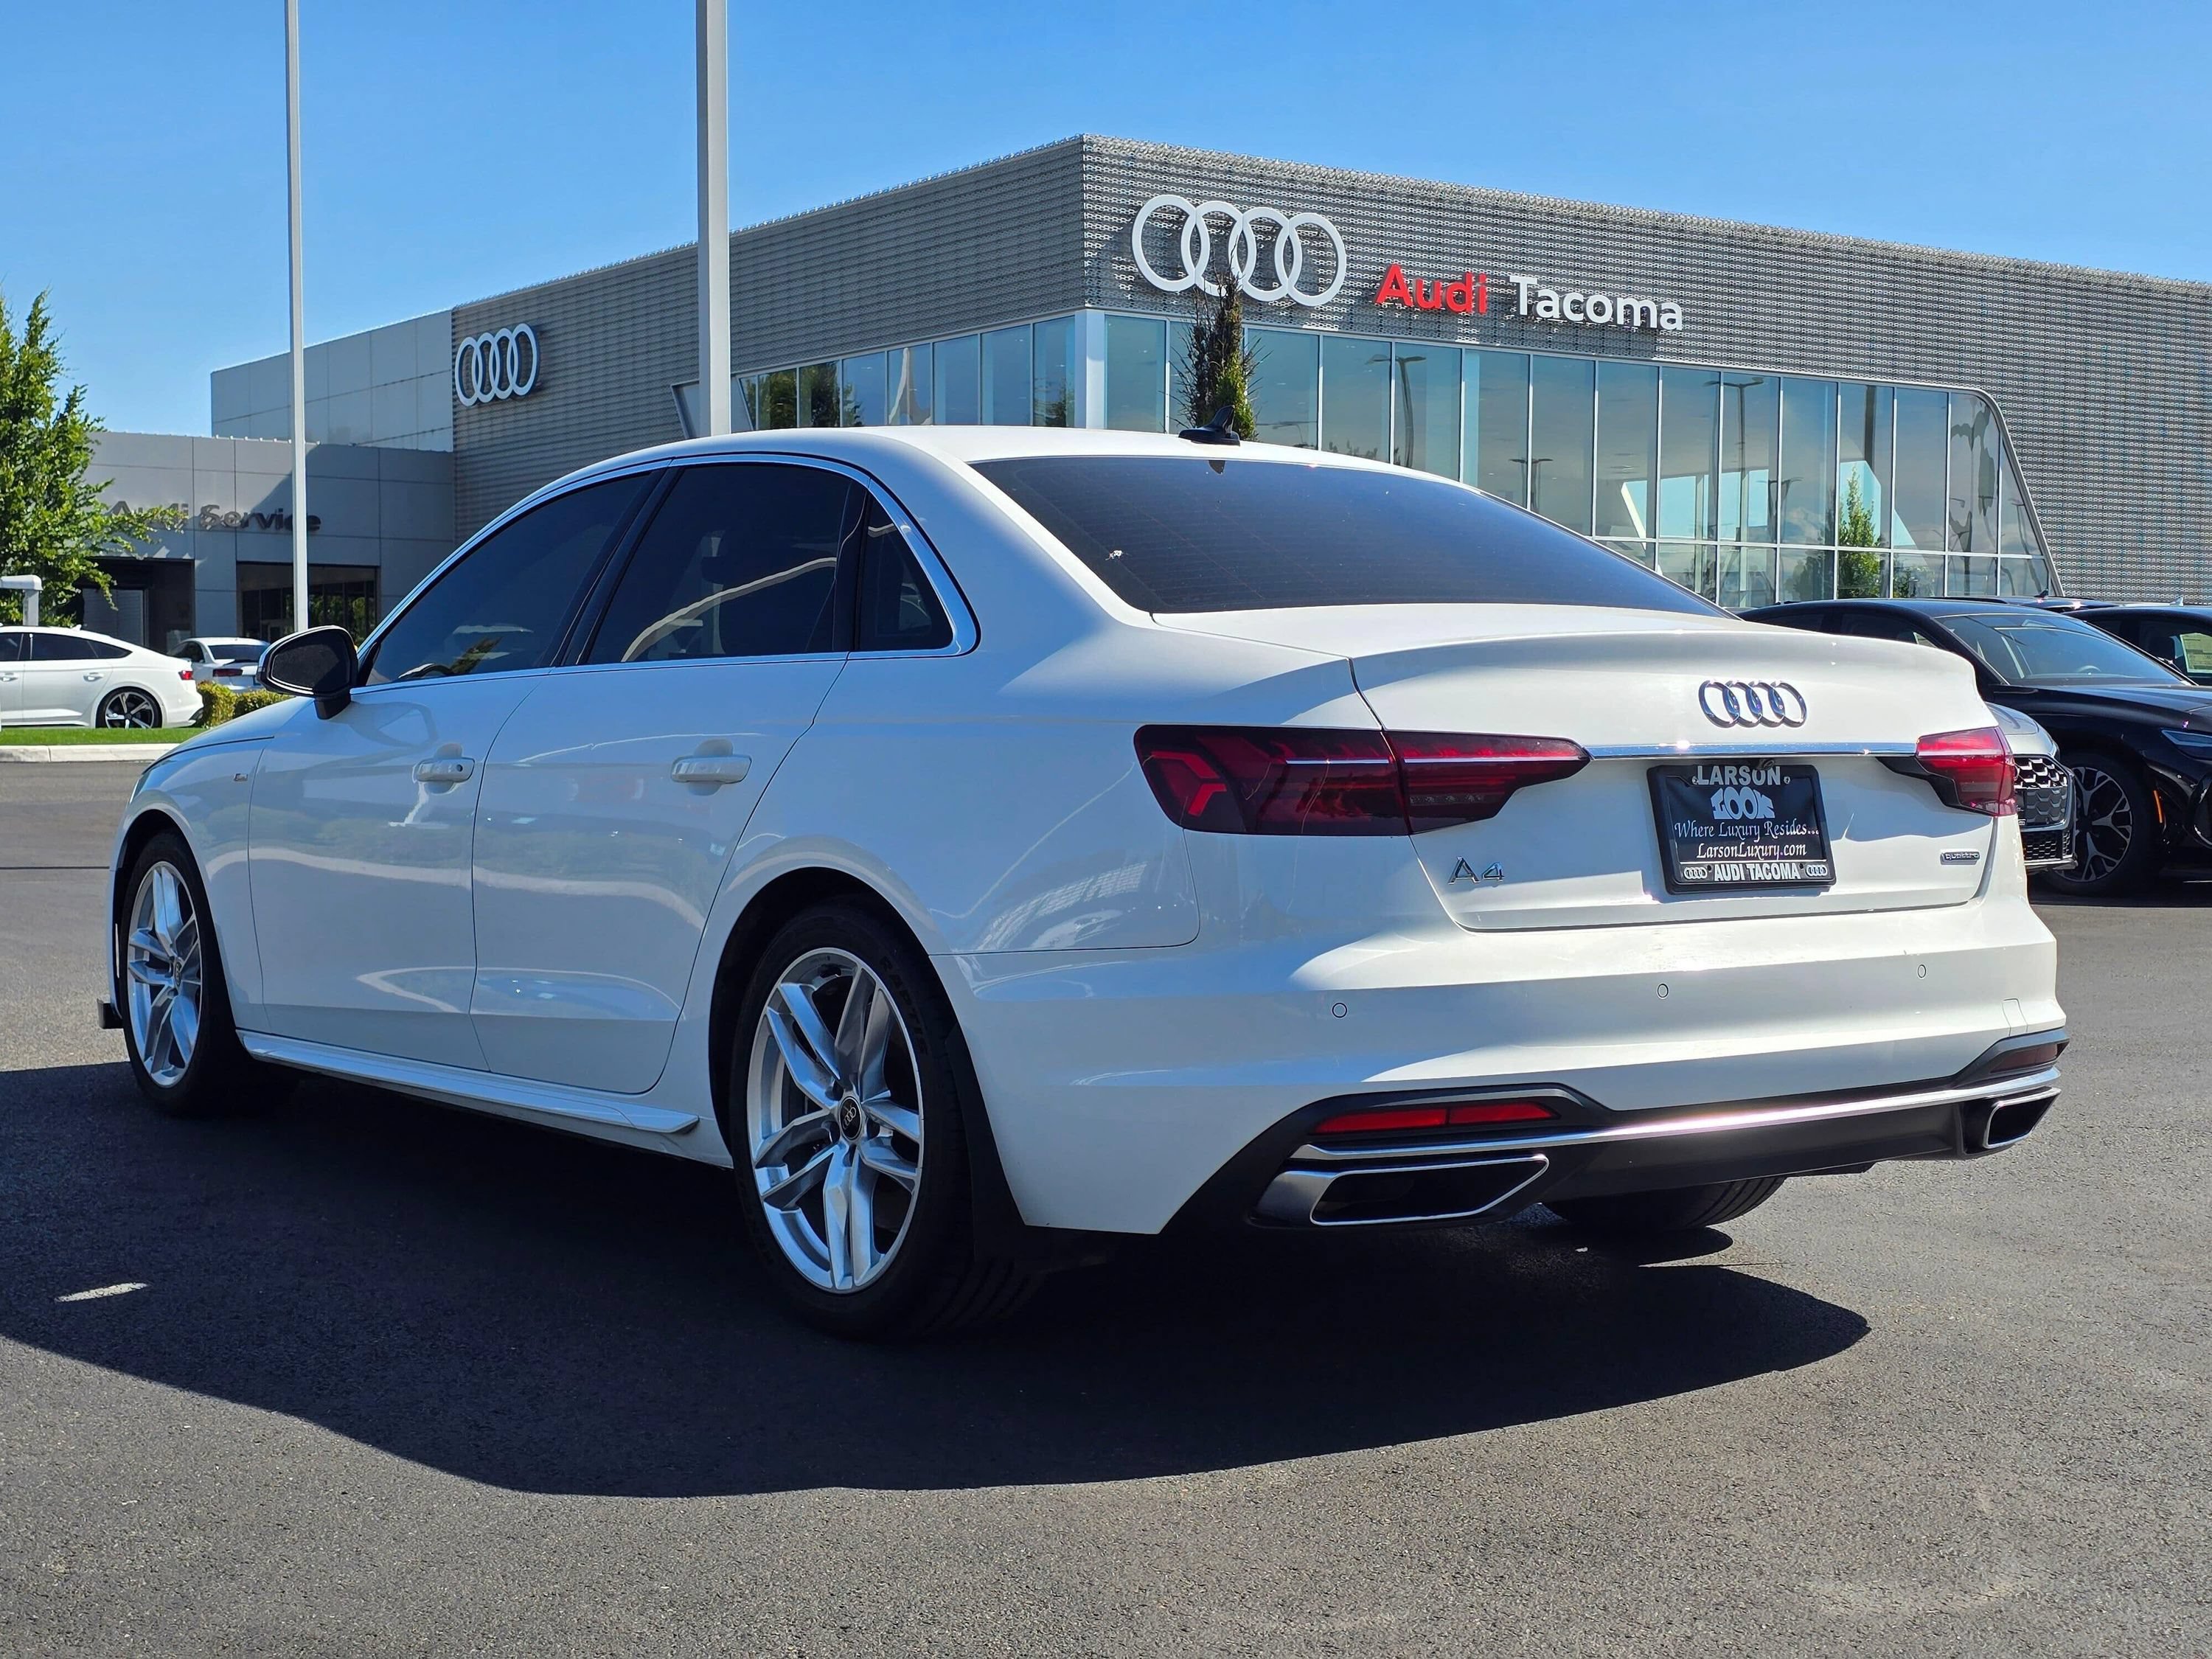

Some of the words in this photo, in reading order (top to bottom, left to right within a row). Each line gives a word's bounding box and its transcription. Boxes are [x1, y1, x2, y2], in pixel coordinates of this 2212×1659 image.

[1374, 264, 1487, 316] Audi
[1509, 276, 1683, 331] Tacoma
[106, 501, 189, 528] Ai
[1697, 765, 1781, 786] LARSON
[1674, 819, 1716, 838] Where
[1718, 821, 1761, 843] Luxury
[1696, 841, 1807, 860] LarsonLuxury.com
[1447, 855, 1505, 885] A4
[1714, 863, 1746, 882] AUDI
[1745, 862, 1802, 881] TACOMA
